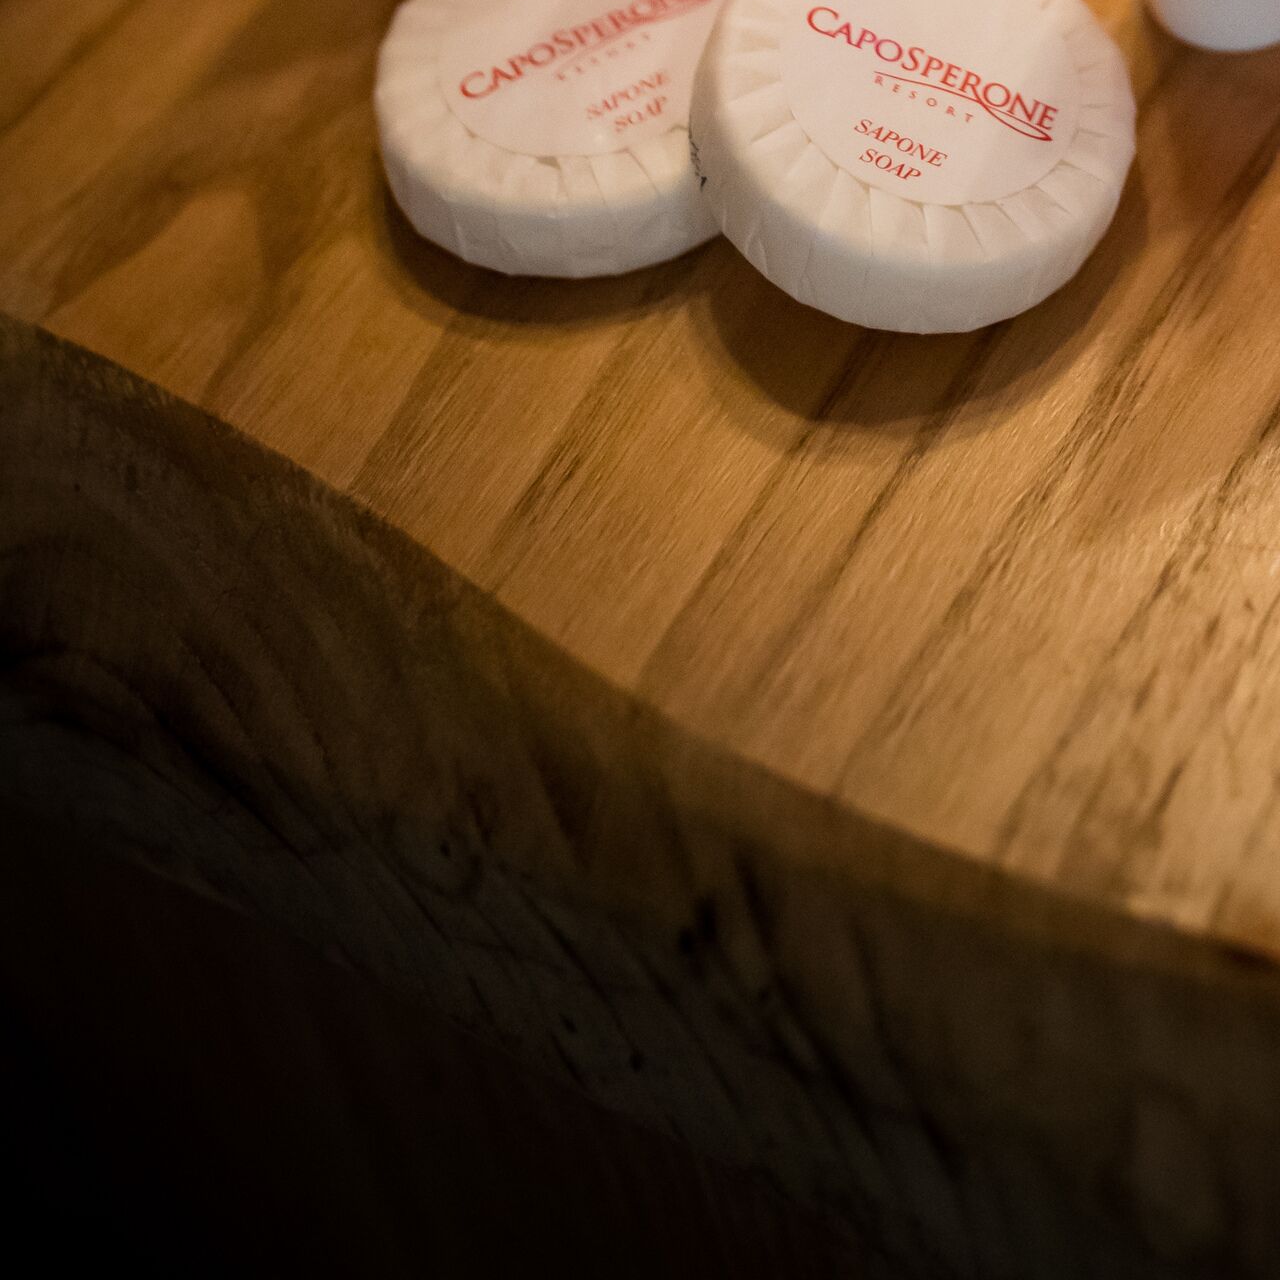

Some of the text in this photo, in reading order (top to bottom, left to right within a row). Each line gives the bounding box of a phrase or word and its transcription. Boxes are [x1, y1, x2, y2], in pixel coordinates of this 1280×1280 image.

[806, 6, 1059, 138] CAPOSPERONE
[874, 75, 974, 123] RESORT
[854, 118, 948, 167] SAPONE
[858, 148, 922, 180] SOAP
